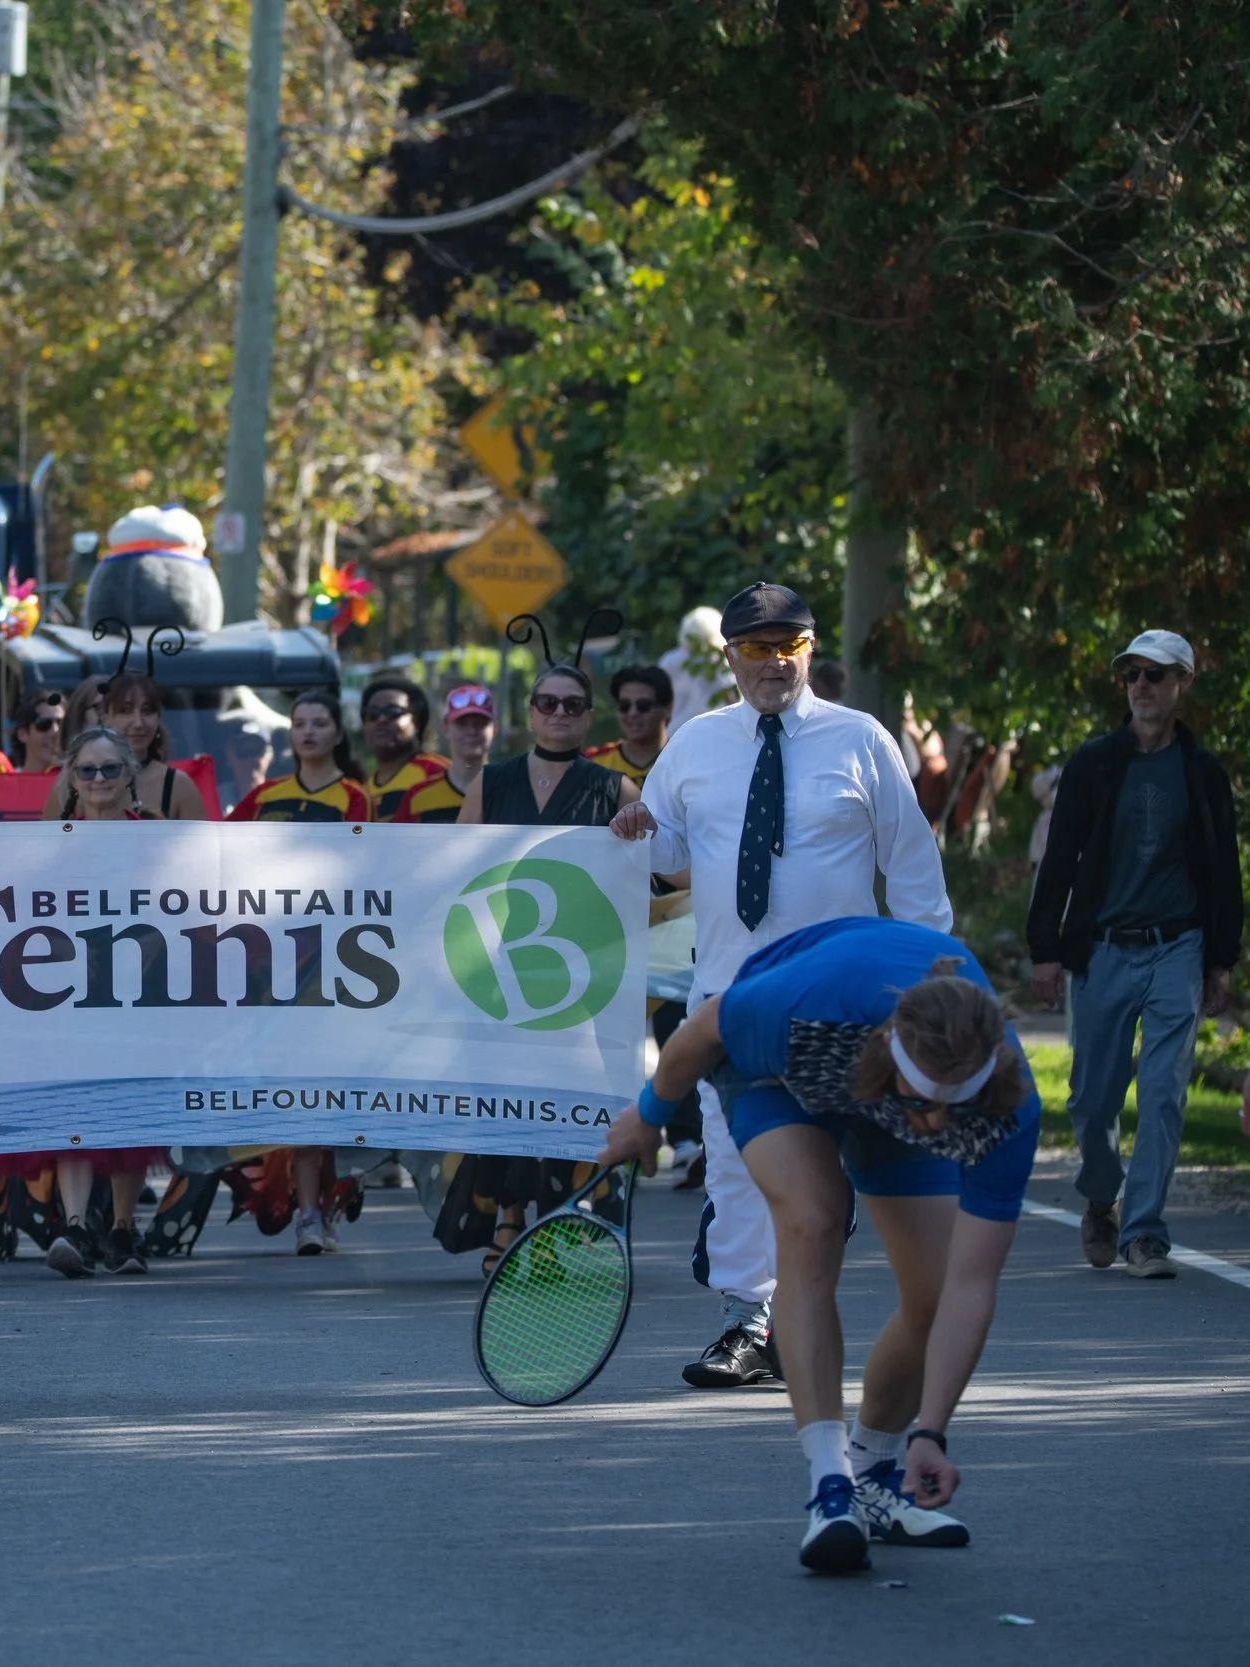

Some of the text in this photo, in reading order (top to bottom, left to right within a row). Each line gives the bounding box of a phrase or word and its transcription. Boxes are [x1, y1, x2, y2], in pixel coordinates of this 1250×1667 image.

[31, 888, 392, 918] BELFOUNTAIN
[448, 876, 592, 1030] B
[184, 1088, 613, 1129] BELFOUNTAINTENNIS.CA
